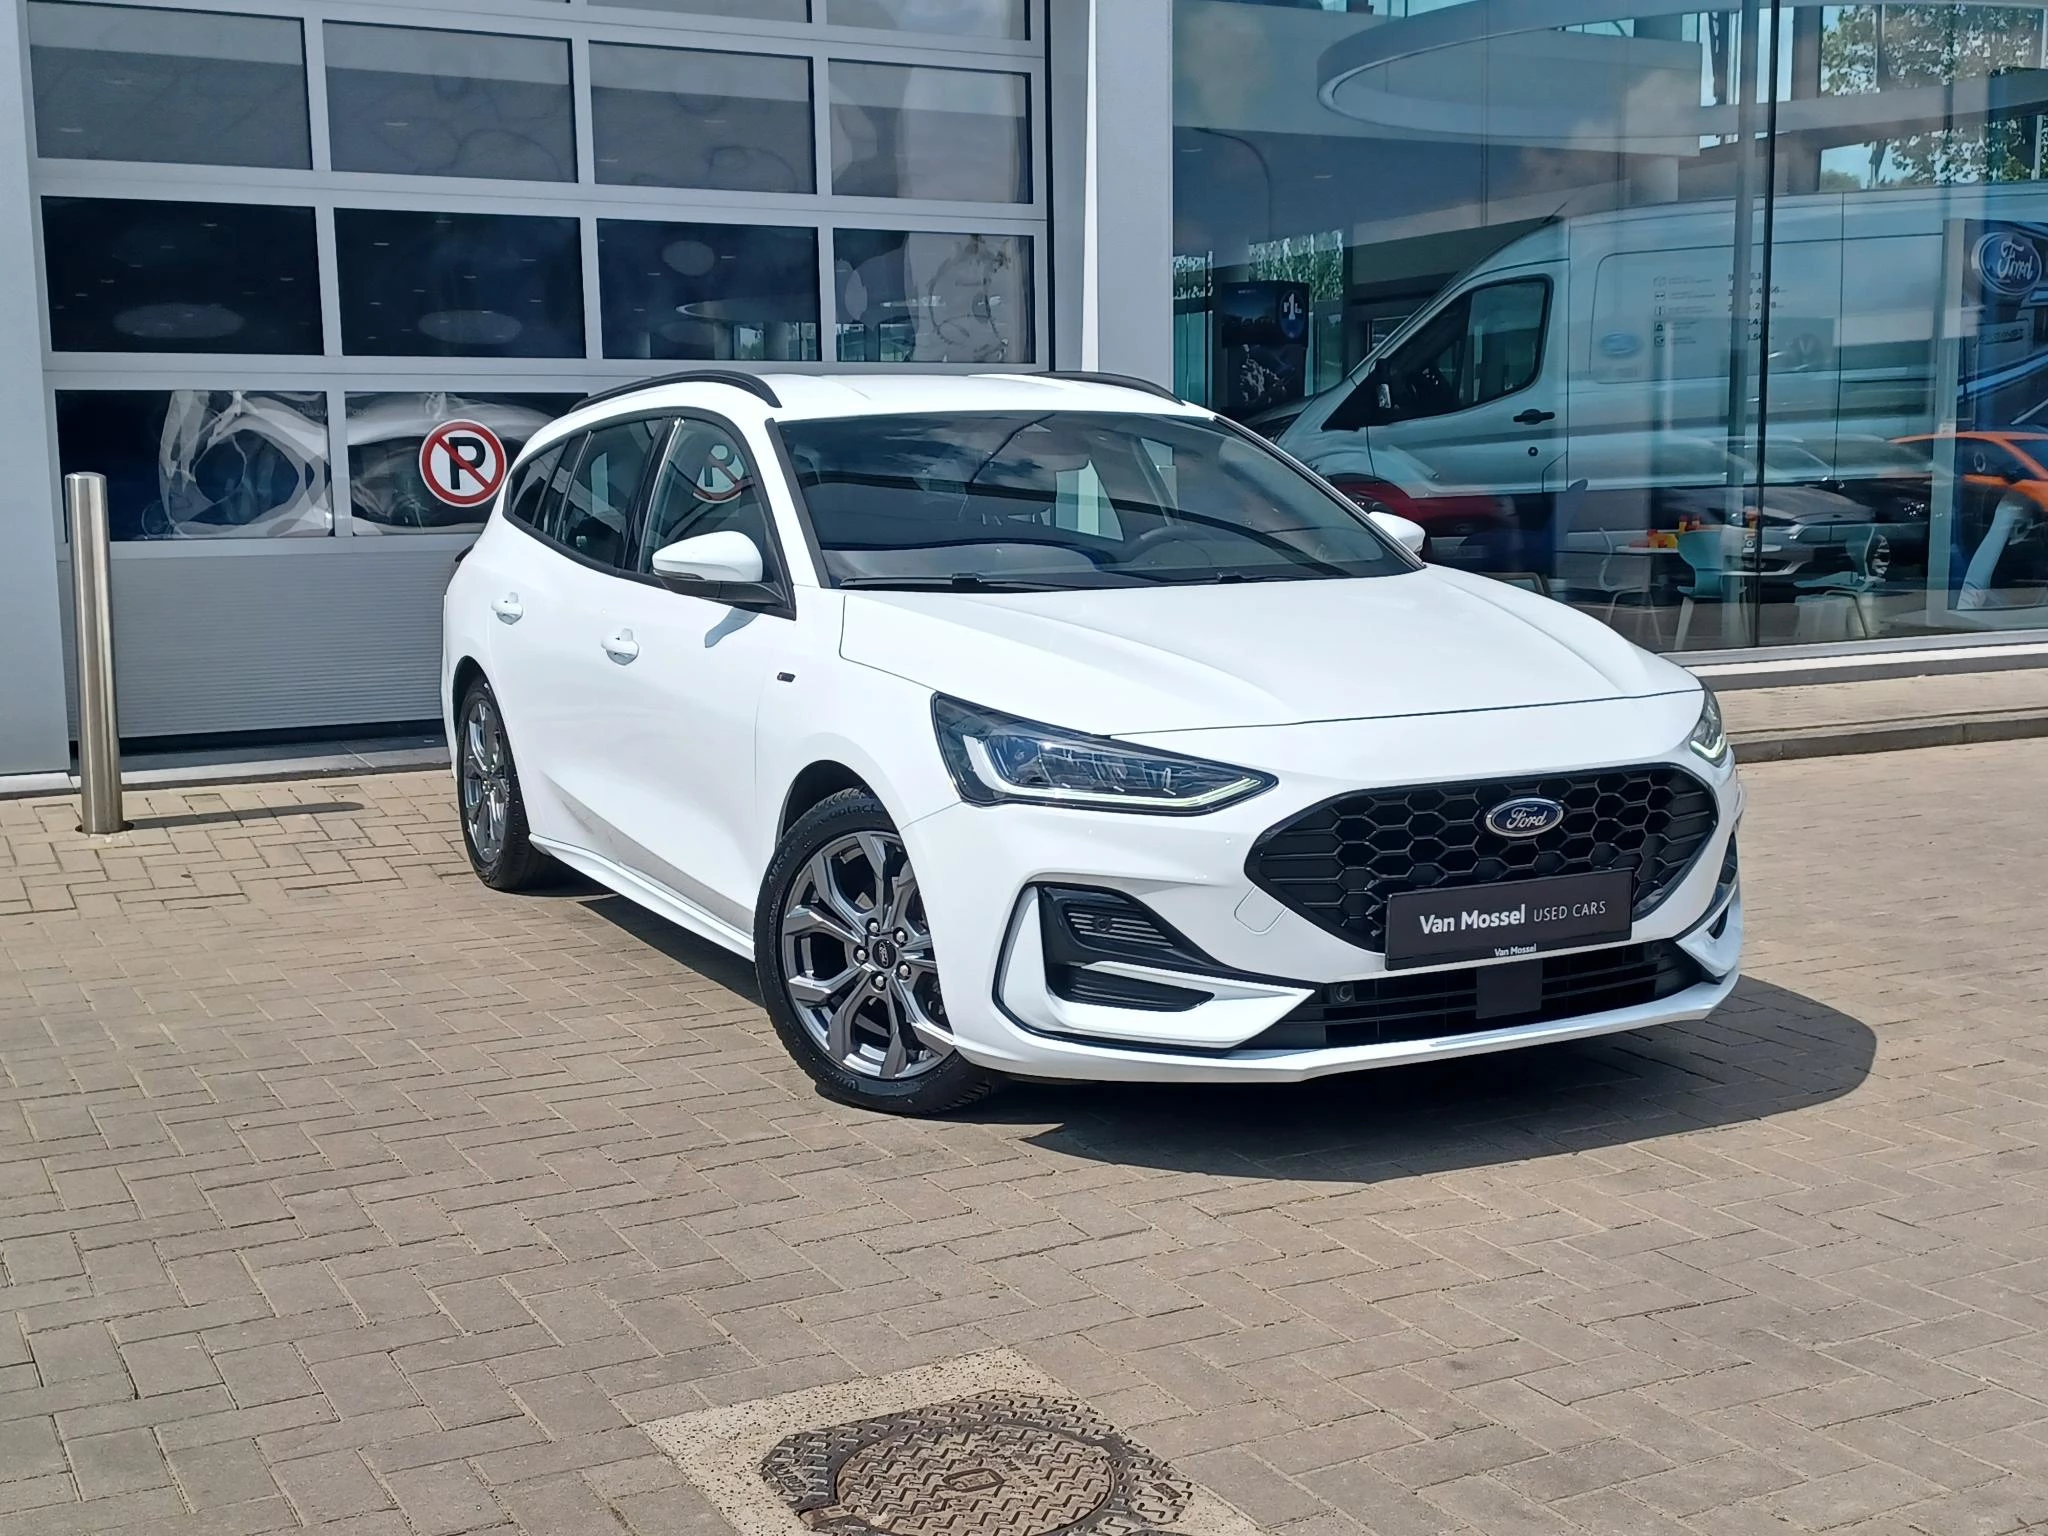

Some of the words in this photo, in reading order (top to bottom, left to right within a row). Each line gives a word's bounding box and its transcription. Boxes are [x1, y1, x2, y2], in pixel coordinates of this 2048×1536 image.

[1998, 240, 2033, 280] Ford
[448, 436, 487, 490] P
[1506, 806, 1547, 829] Ford
[1419, 914, 1455, 934] Van
[1460, 903, 1526, 931] Mossel
[1533, 904, 1568, 922] USED
[1572, 900, 1607, 918] CARS
[1494, 947, 1510, 957] Van
[1510, 943, 1537, 955] Mossel
